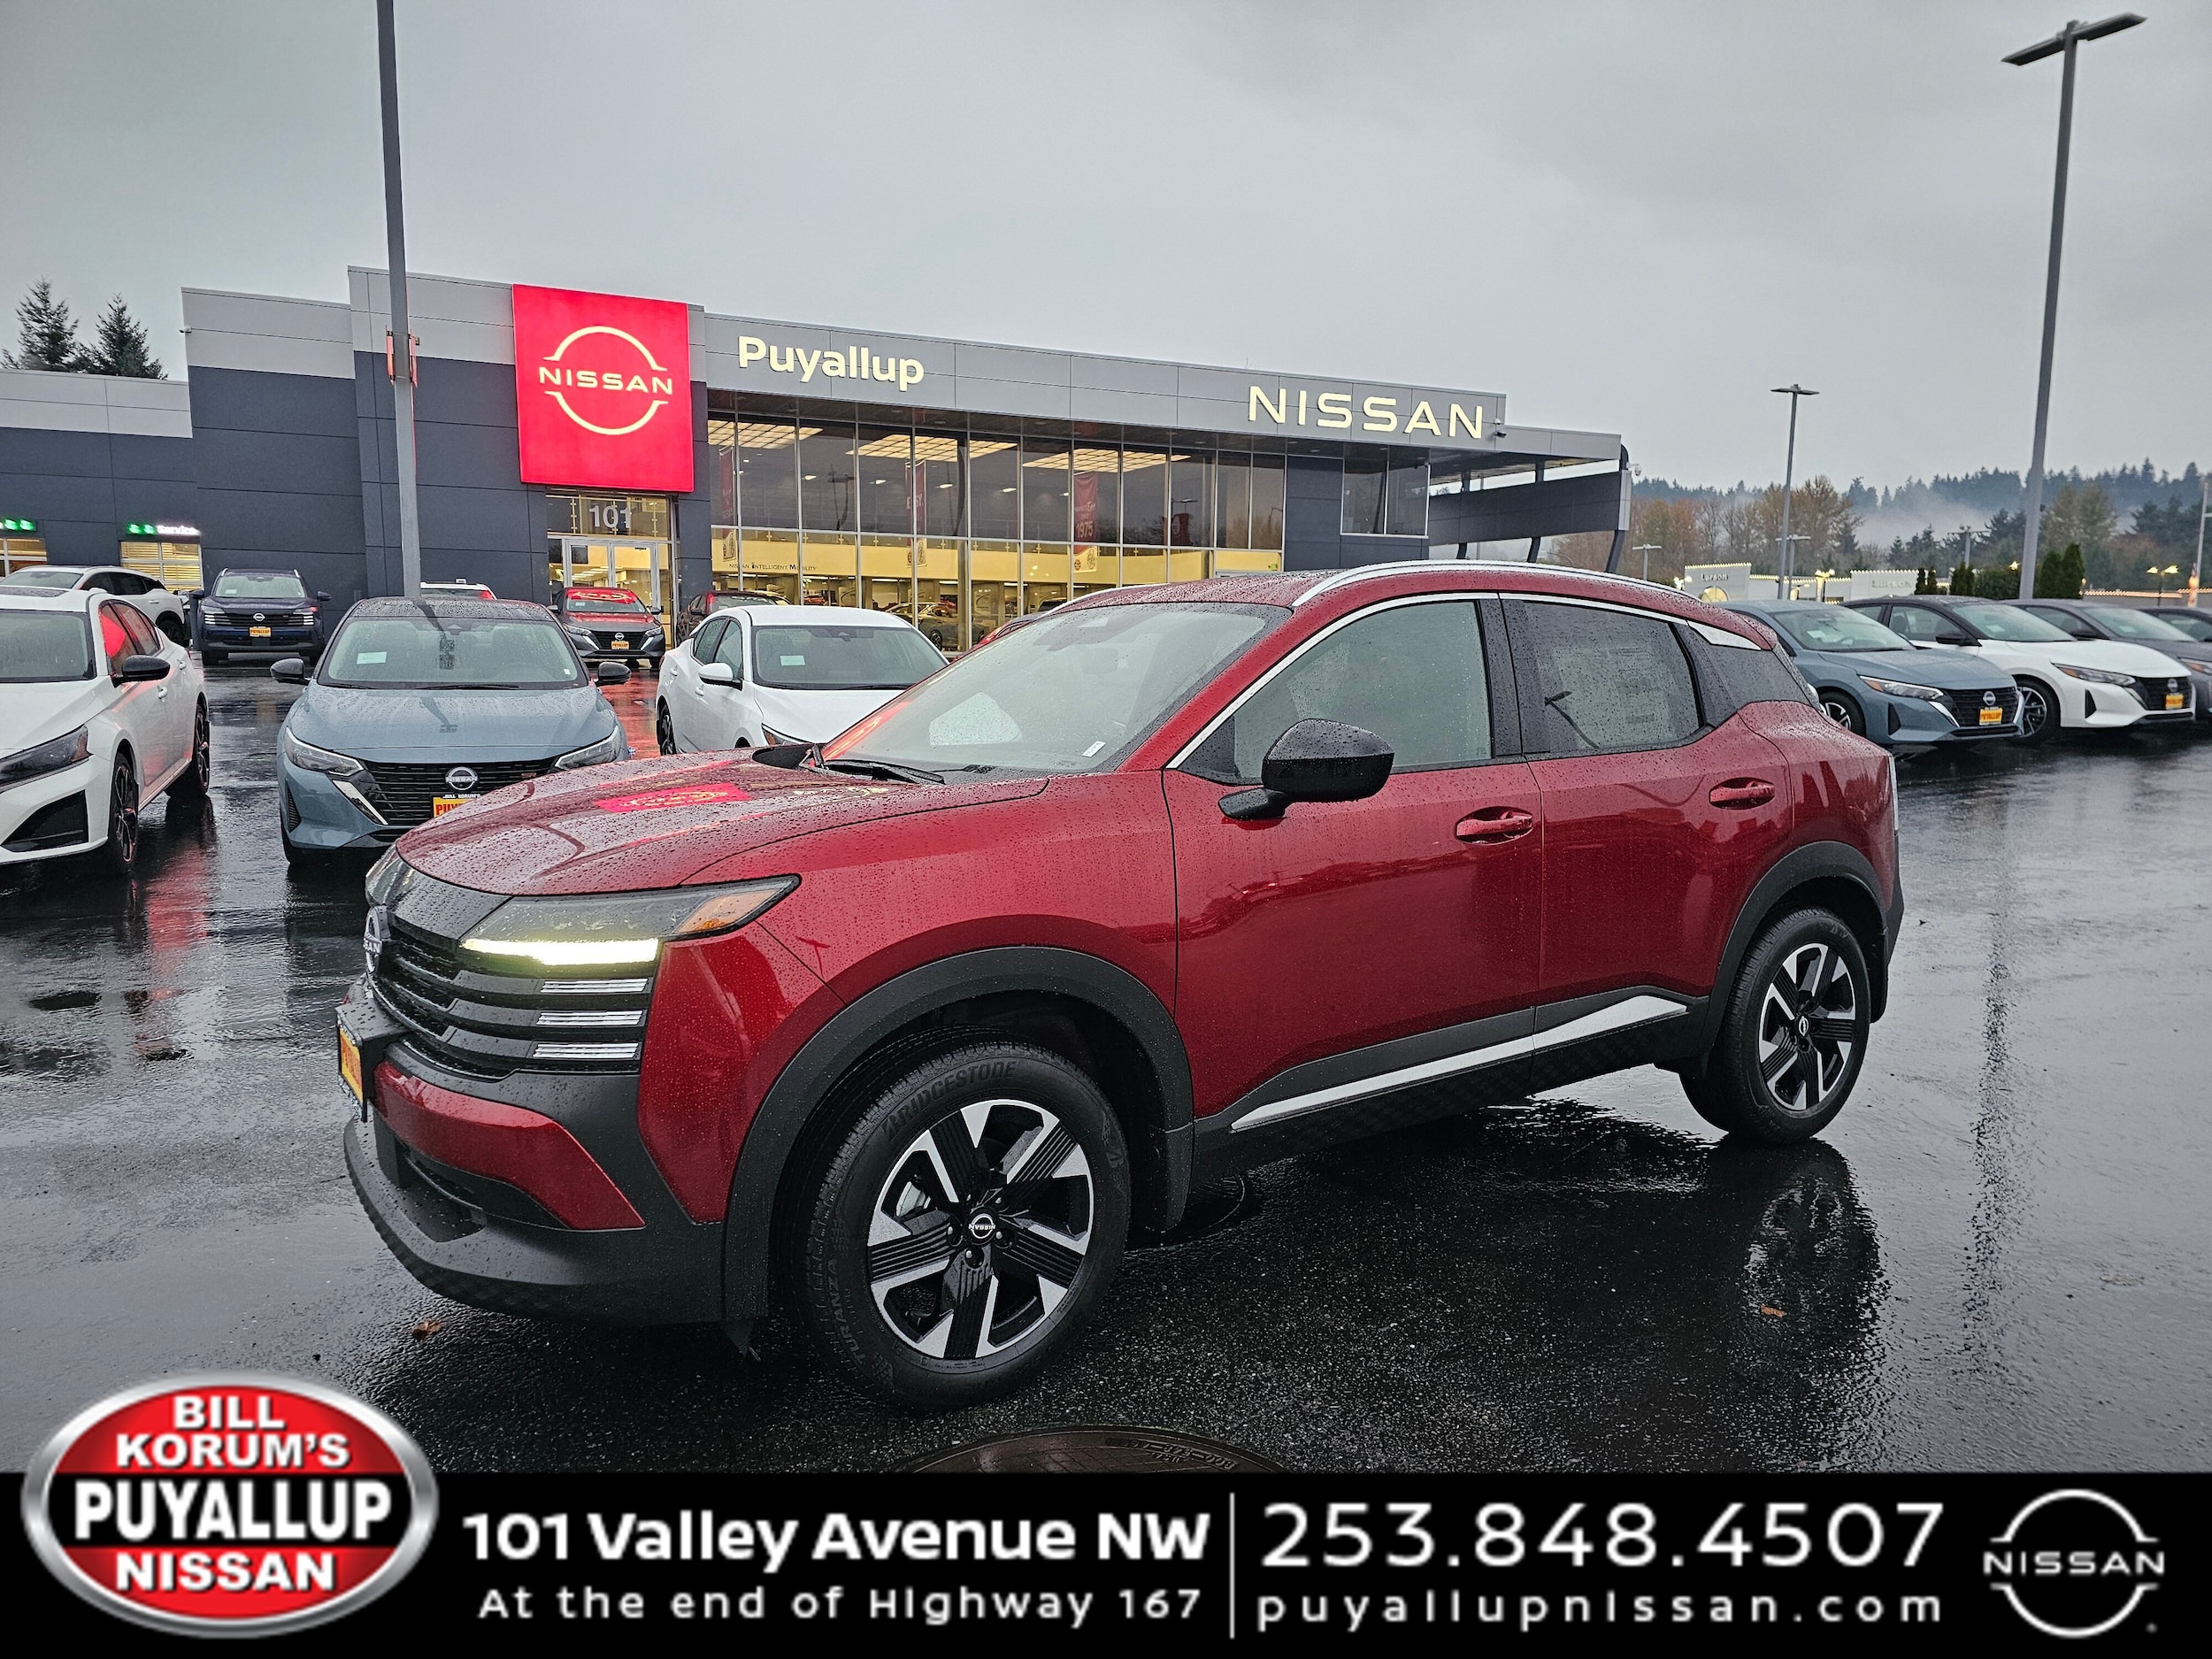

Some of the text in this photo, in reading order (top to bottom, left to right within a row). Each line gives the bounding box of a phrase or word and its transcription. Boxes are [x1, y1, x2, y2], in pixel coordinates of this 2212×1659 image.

[539, 366, 672, 395] NISSAN
[738, 335, 925, 391] Puyallup
[1248, 386, 1483, 439] NISSAN
[589, 505, 632, 529] 101
[1076, 520, 1094, 538] 1975
[882, 1061, 1017, 1142] BRIDGESTONE
[826, 1257, 865, 1363] TURANZA
